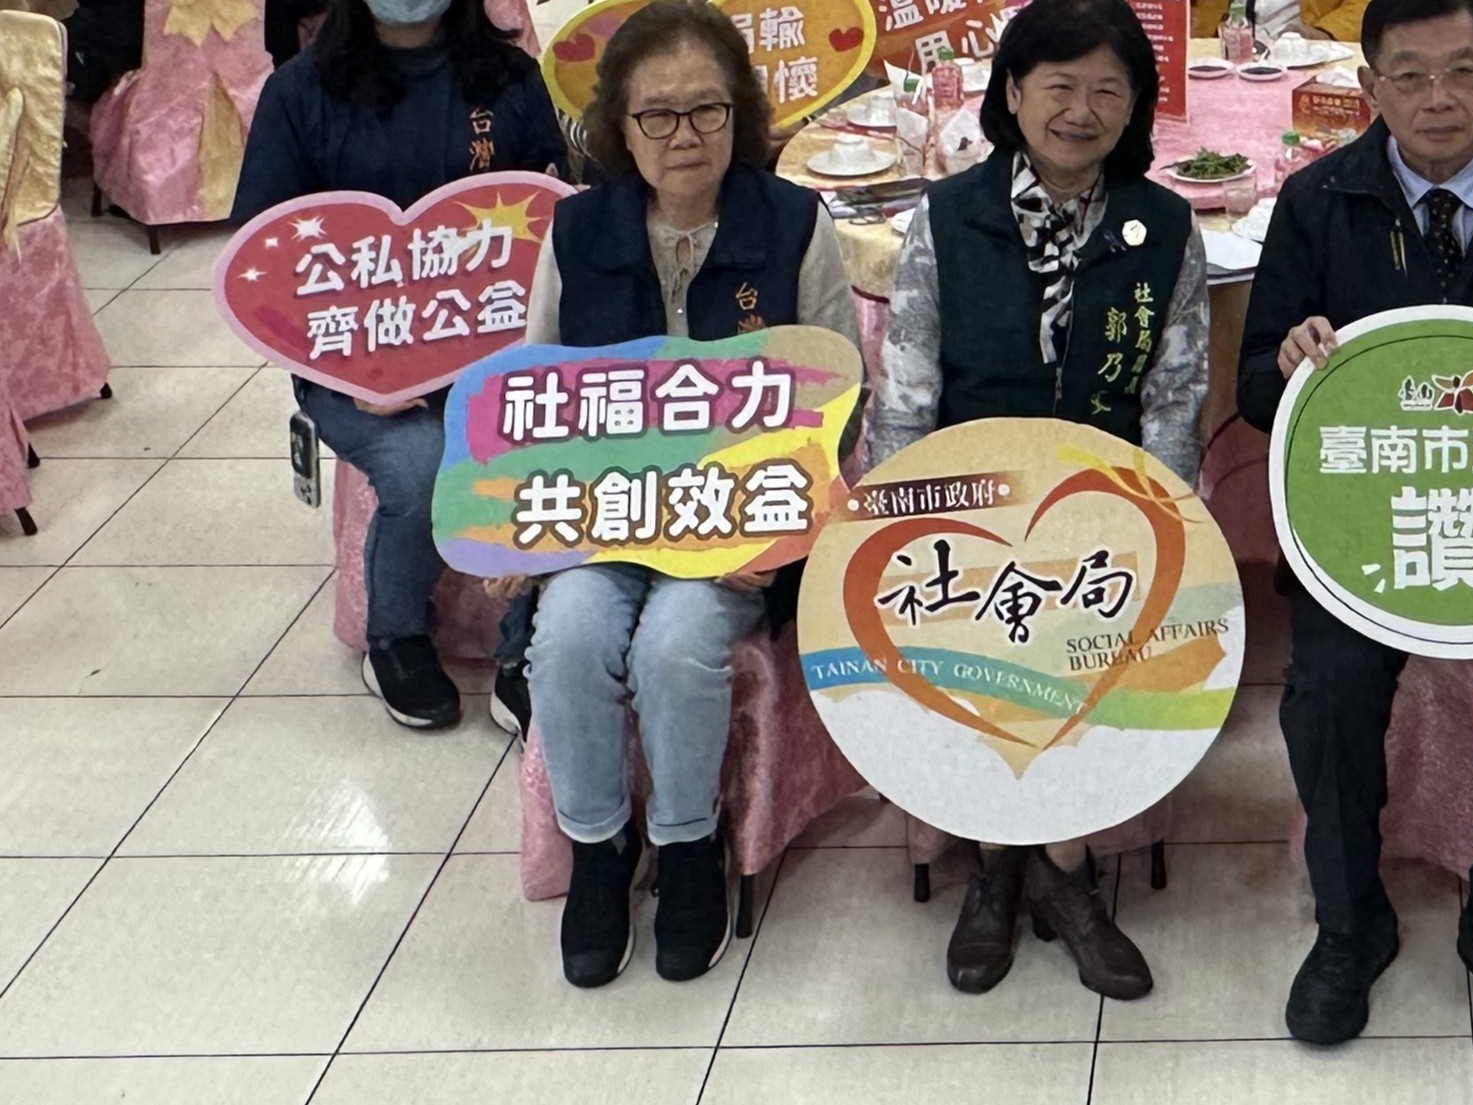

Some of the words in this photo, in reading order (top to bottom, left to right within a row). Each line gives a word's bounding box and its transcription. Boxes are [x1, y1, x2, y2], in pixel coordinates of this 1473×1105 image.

[294, 218, 514, 297] 公私協力
[307, 280, 527, 360] 齊做公益
[502, 360, 793, 441] 社福合力
[516, 463, 809, 546] 共創效益
[878, 539, 1136, 644] 社會局
[1066, 631, 1140, 655] SOCIAL
[1146, 617, 1231, 644] AFFAIRS
[1067, 645, 1153, 673] BUREAU
[811, 658, 888, 681] TAINAN
[897, 659, 945, 676] CITY
[953, 664, 1089, 717] GOVERNMENT
